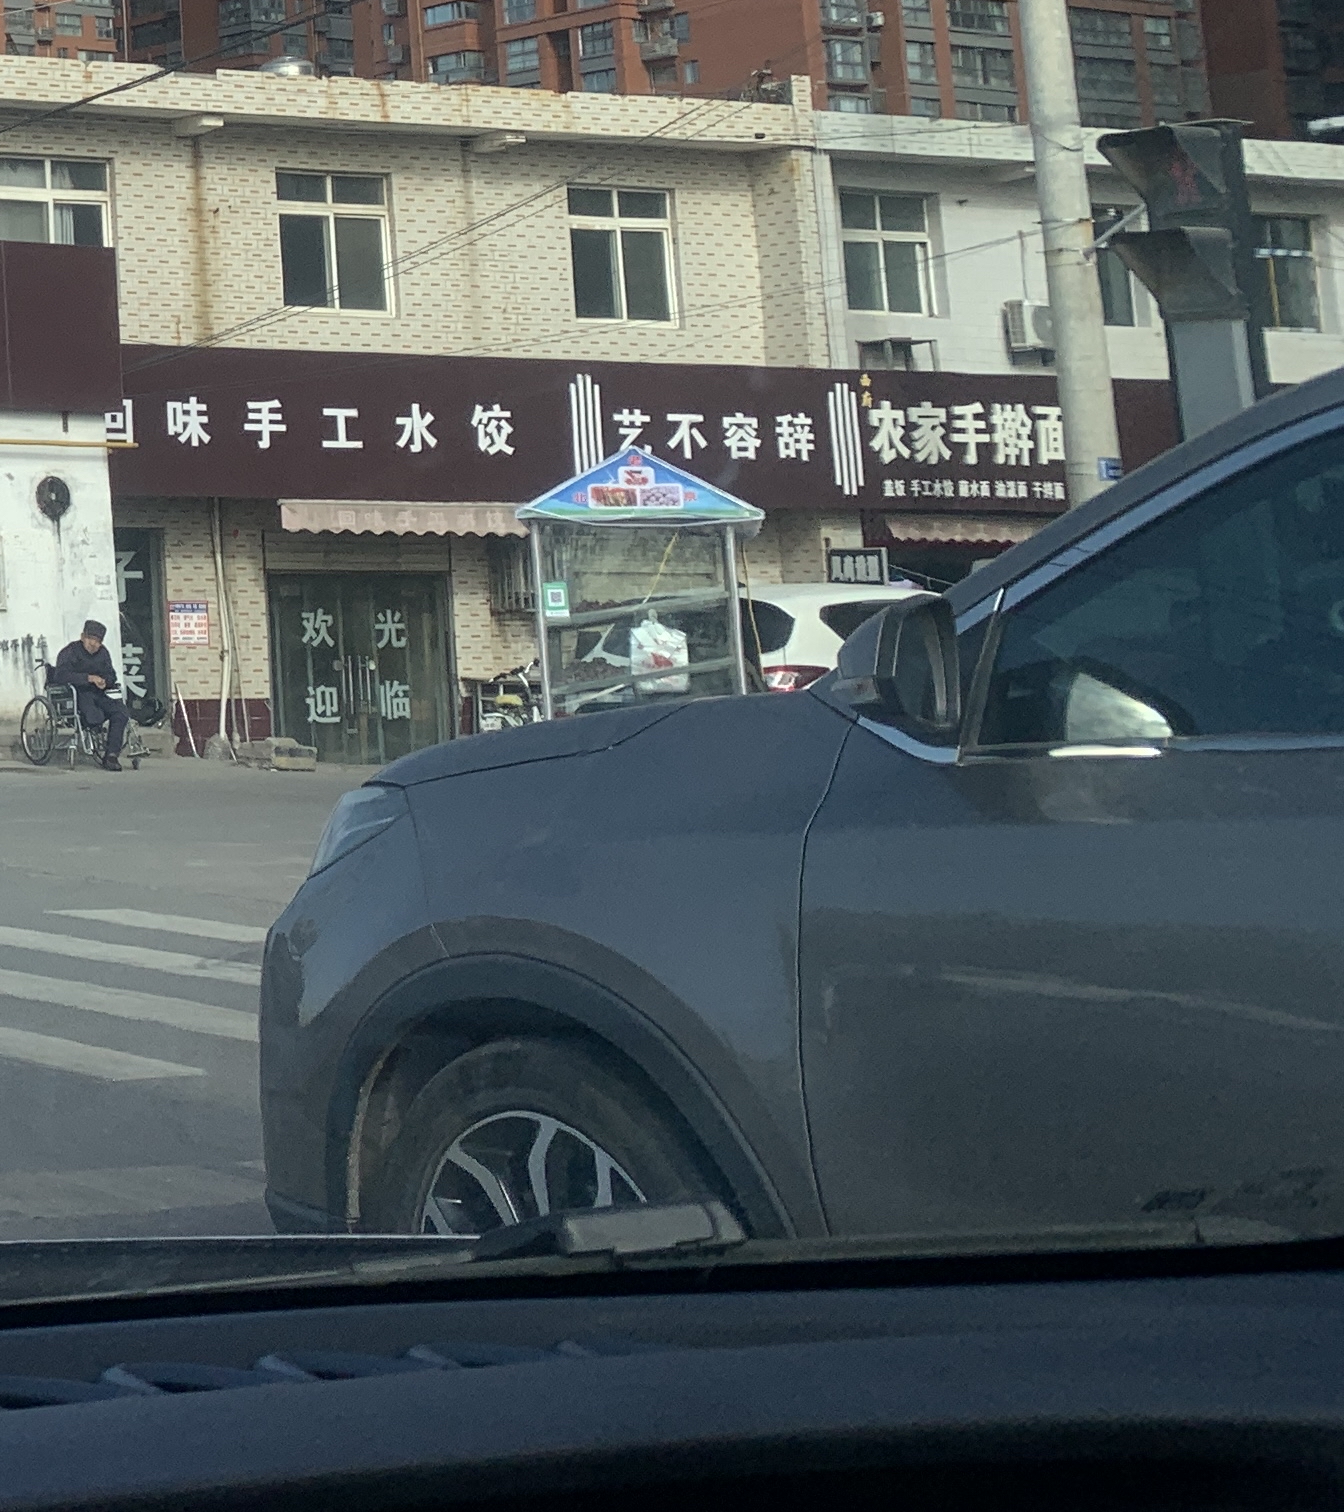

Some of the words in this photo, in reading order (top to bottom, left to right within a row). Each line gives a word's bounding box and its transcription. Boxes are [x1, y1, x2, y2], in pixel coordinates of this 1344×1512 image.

[105, 397, 515, 456] 回味手工水饺
[613, 409, 816, 461] 艺不容辞
[869, 400, 1067, 466] 农家手擀面
[301, 609, 341, 724] 欢迎
[374, 610, 412, 721] 光临
